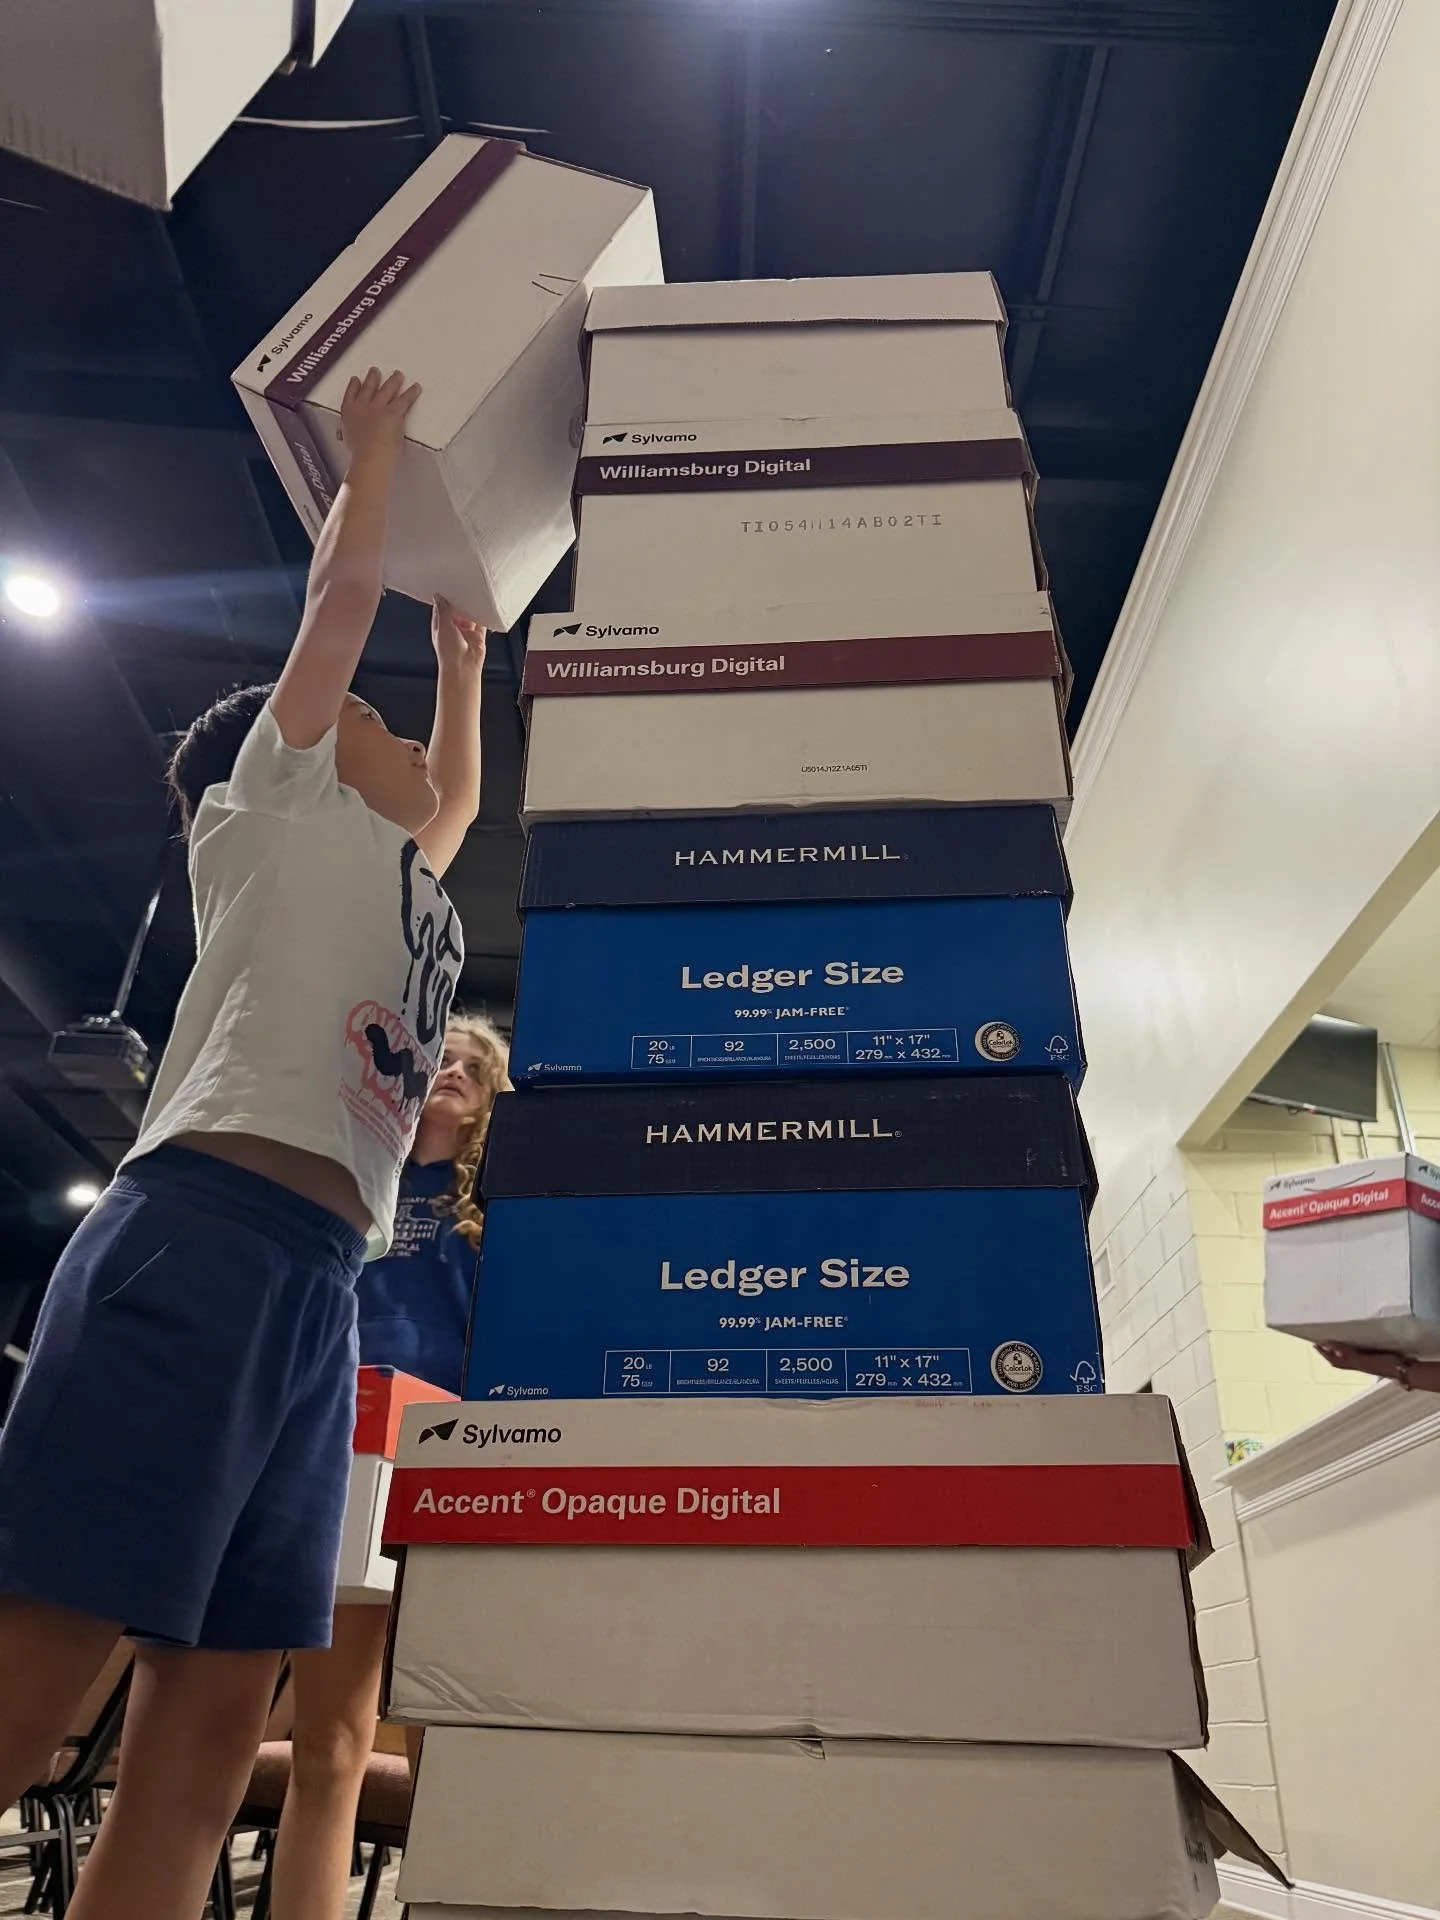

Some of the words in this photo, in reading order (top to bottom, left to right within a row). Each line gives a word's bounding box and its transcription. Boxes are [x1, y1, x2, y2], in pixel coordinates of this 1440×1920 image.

[286, 296, 376, 383] Williamsburg
[366, 255, 410, 296] Digital
[271, 313, 314, 355] Sylvamo
[631, 433, 697, 445] Sylvamo
[599, 463, 739, 479] Williamsburg
[745, 458, 811, 475] Digital
[585, 625, 660, 639] Sylvamo
[546, 660, 705, 678] Williamsburg
[711, 655, 785, 676] Digital
[681, 964, 813, 994] Ledger
[823, 961, 904, 986] Size
[649, 1040, 668, 1051] 20
[724, 1041, 745, 1052] 92
[788, 1038, 836, 1052] 2,500
[895, 1037, 904, 1045] x
[647, 1054, 665, 1065] 75
[855, 1049, 883, 1060] 279
[897, 1051, 907, 1059] x
[910, 1048, 941, 1059] 432
[1308, 1197, 1351, 1214] Opaque
[1352, 1188, 1389, 1207] Digital
[660, 1259, 807, 1297] Ledger
[819, 1258, 910, 1288] Size
[623, 1356, 645, 1370] 20
[707, 1358, 729, 1372] 92
[779, 1357, 833, 1374] 2,500
[900, 1358, 910, 1368] x
[621, 1374, 640, 1387] 75
[855, 1373, 886, 1386] 279
[902, 1376, 913, 1387] x
[917, 1373, 952, 1387] 432
[507, 1386, 549, 1398] Sylvamo
[1075, 1384, 1097, 1393] FSC
[462, 1423, 562, 1449] Sylvamo
[542, 1487, 667, 1520] Opaque
[676, 1487, 781, 1520] Digital
